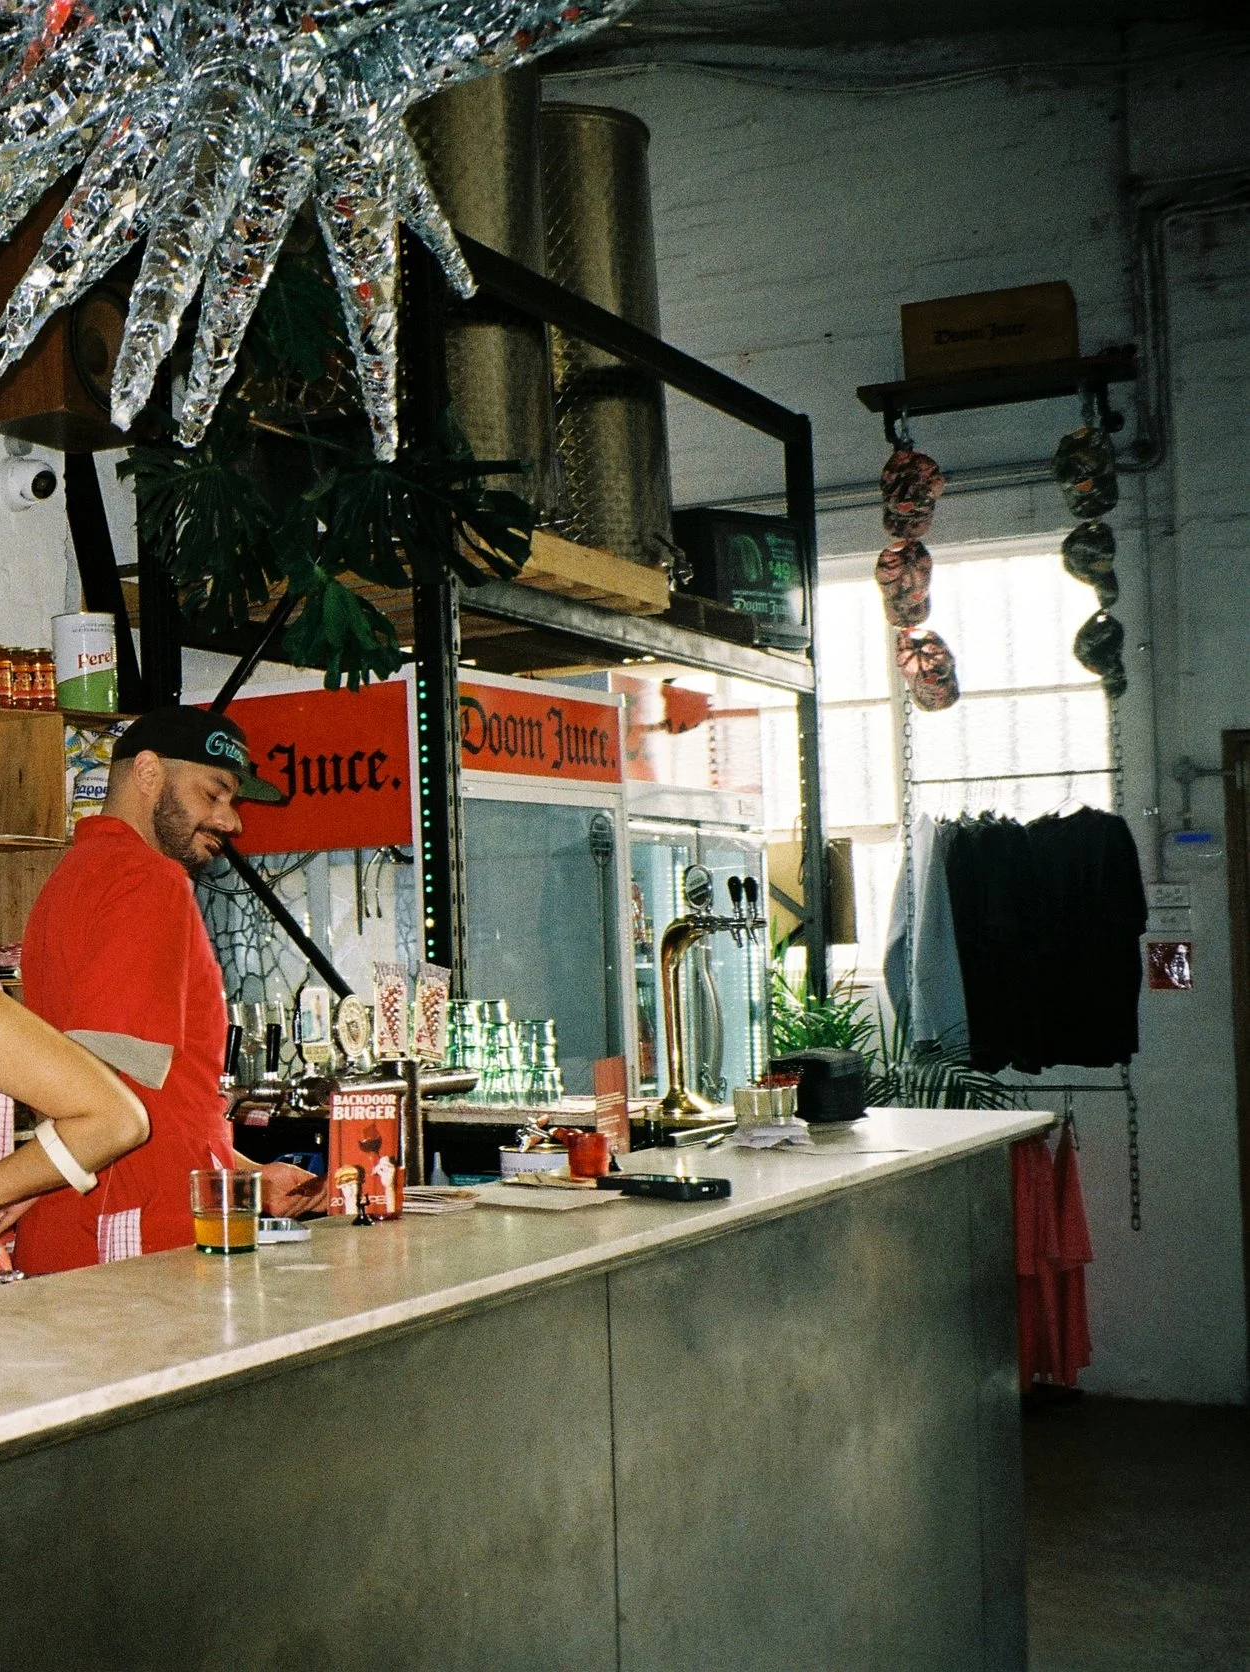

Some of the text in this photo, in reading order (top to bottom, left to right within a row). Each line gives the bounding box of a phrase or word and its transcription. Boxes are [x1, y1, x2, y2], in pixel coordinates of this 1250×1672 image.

[933, 327, 984, 345] Doom
[77, 646, 114, 669] Perel
[460, 697, 616, 770] Doom Juice.
[267, 742, 402, 801] Juice.
[332, 1094, 397, 1106] BACKDOOR
[332, 1105, 396, 1120] BURGER
[330, 1196, 344, 1207] 20
